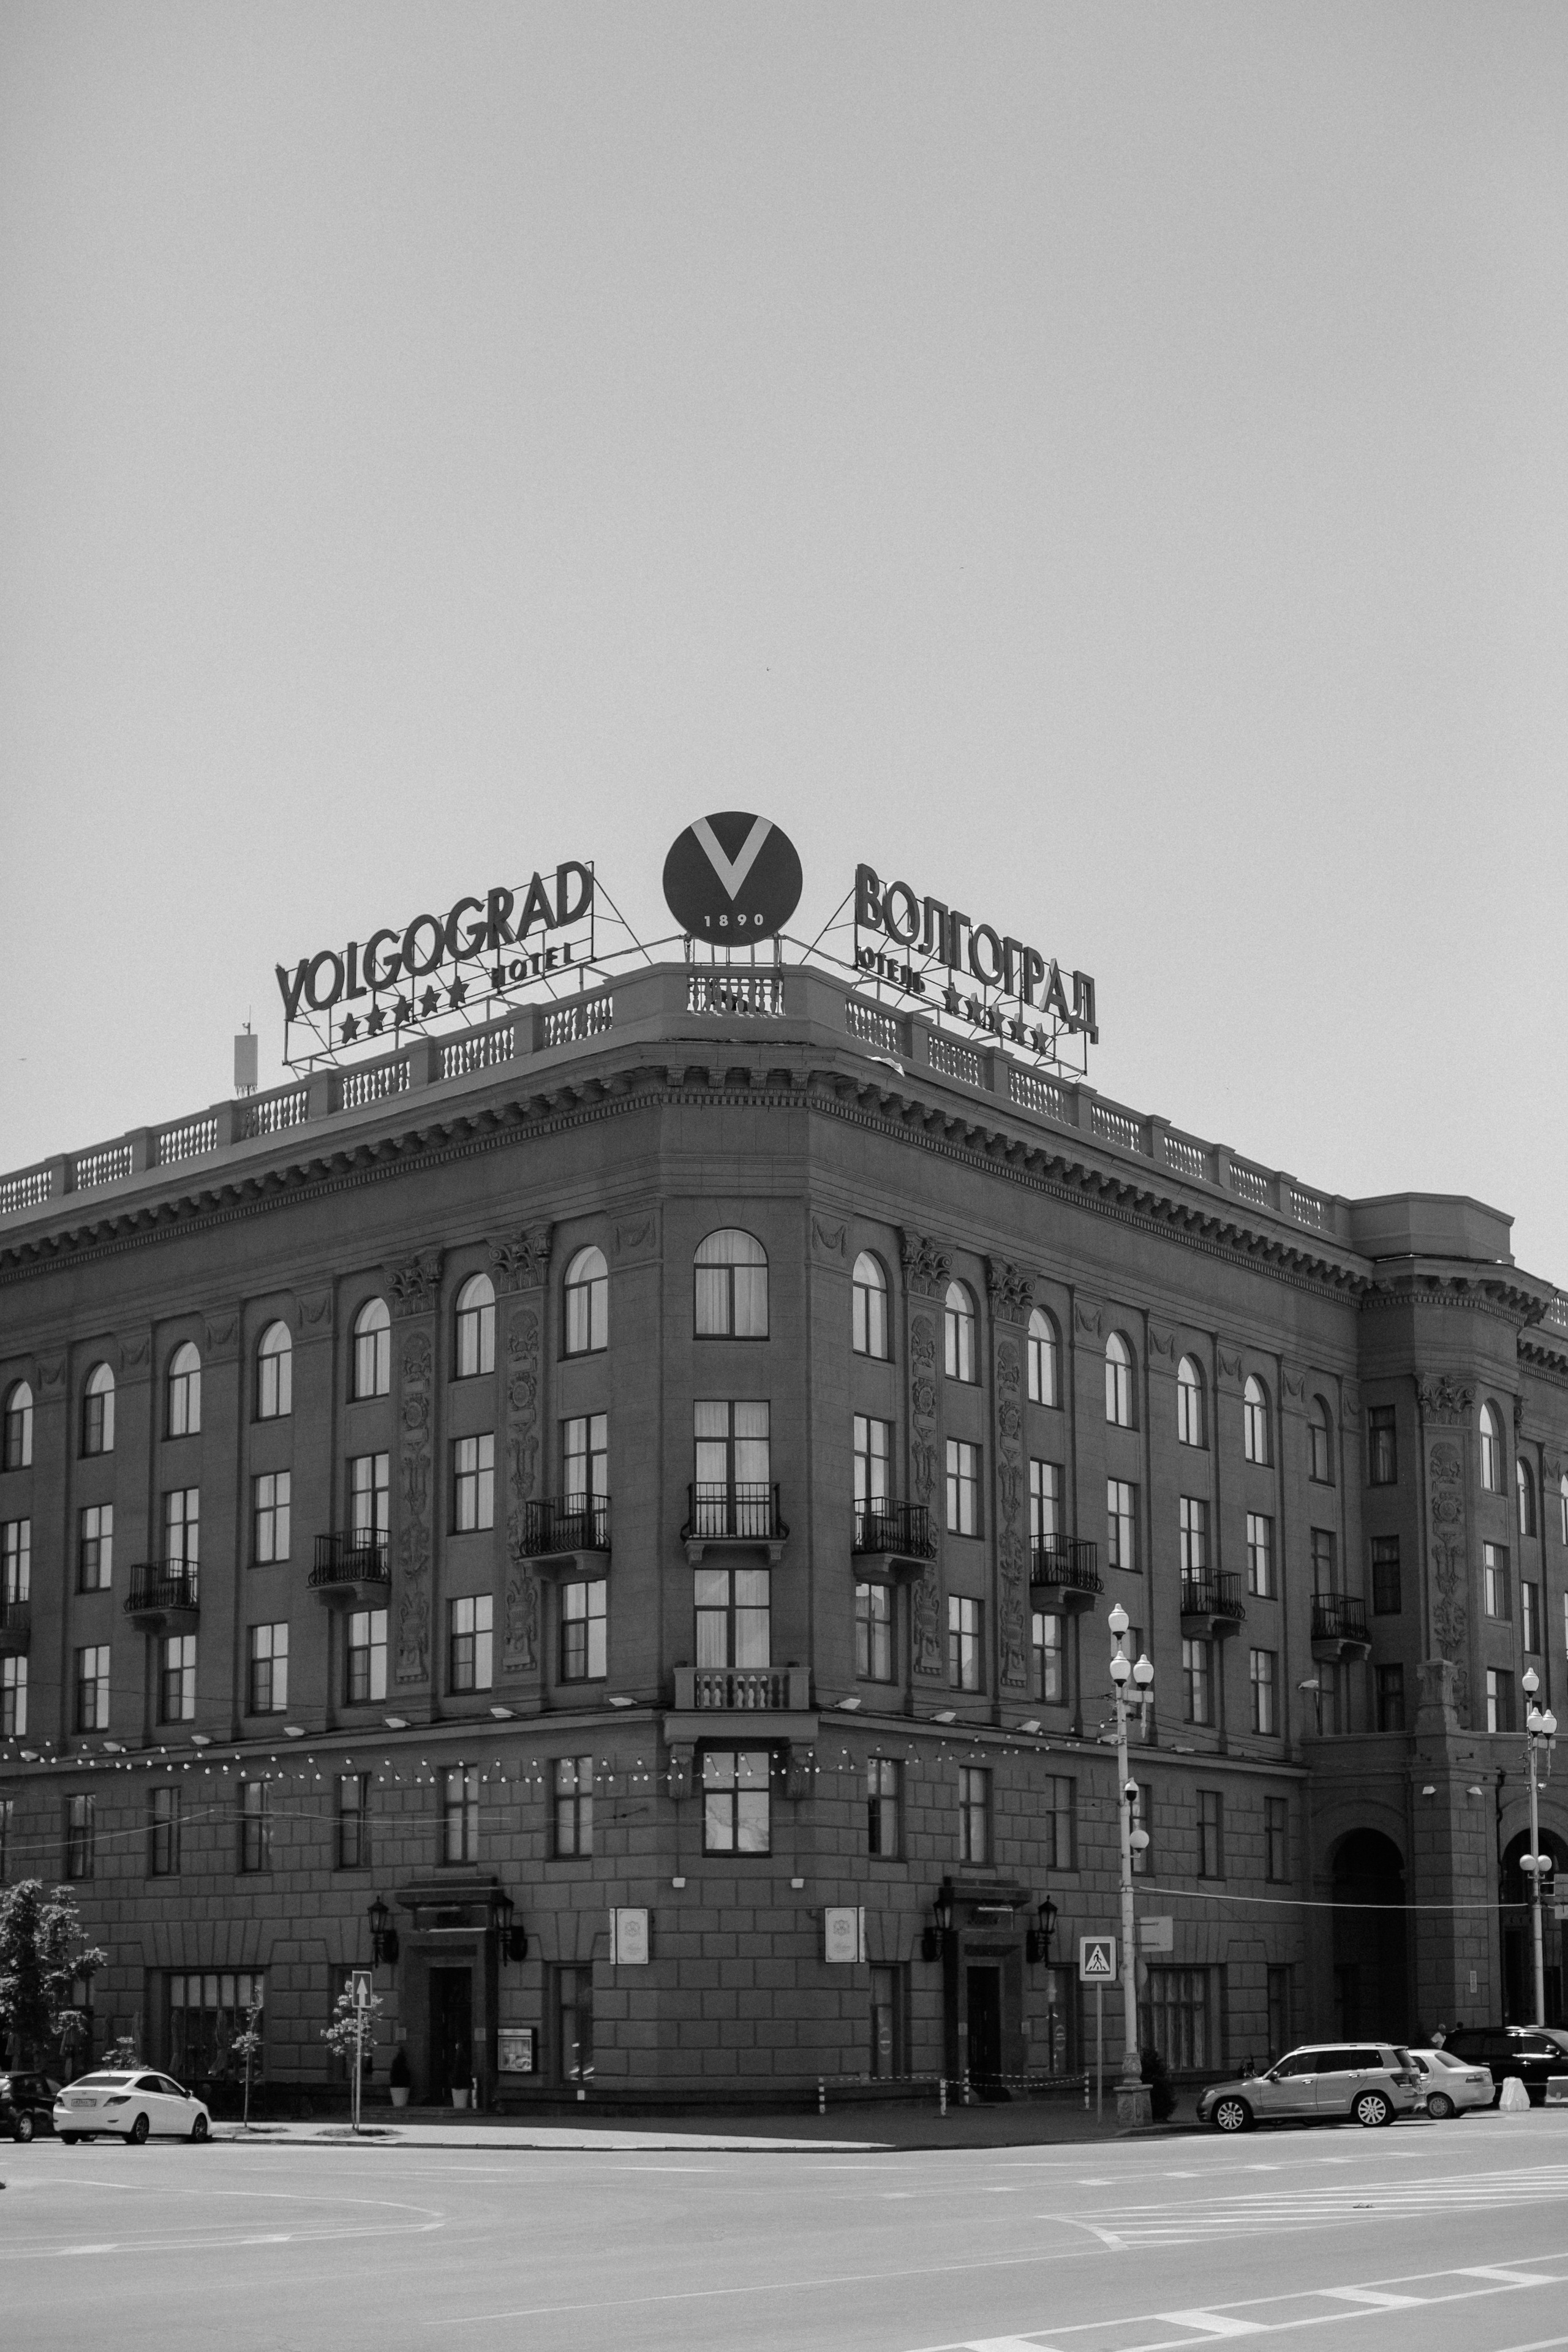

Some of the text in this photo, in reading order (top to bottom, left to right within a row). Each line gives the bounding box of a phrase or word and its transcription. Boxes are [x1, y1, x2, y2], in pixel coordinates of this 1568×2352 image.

[690, 816, 773, 901] V
[275, 861, 592, 1021] VOLGOGRAD
[704, 914, 764, 927] 1890
[856, 863, 1099, 1044] ВОЛГОГРАД
[491, 942, 575, 988] HOTEL
[858, 946, 925, 993] ОТЕЛЬ
